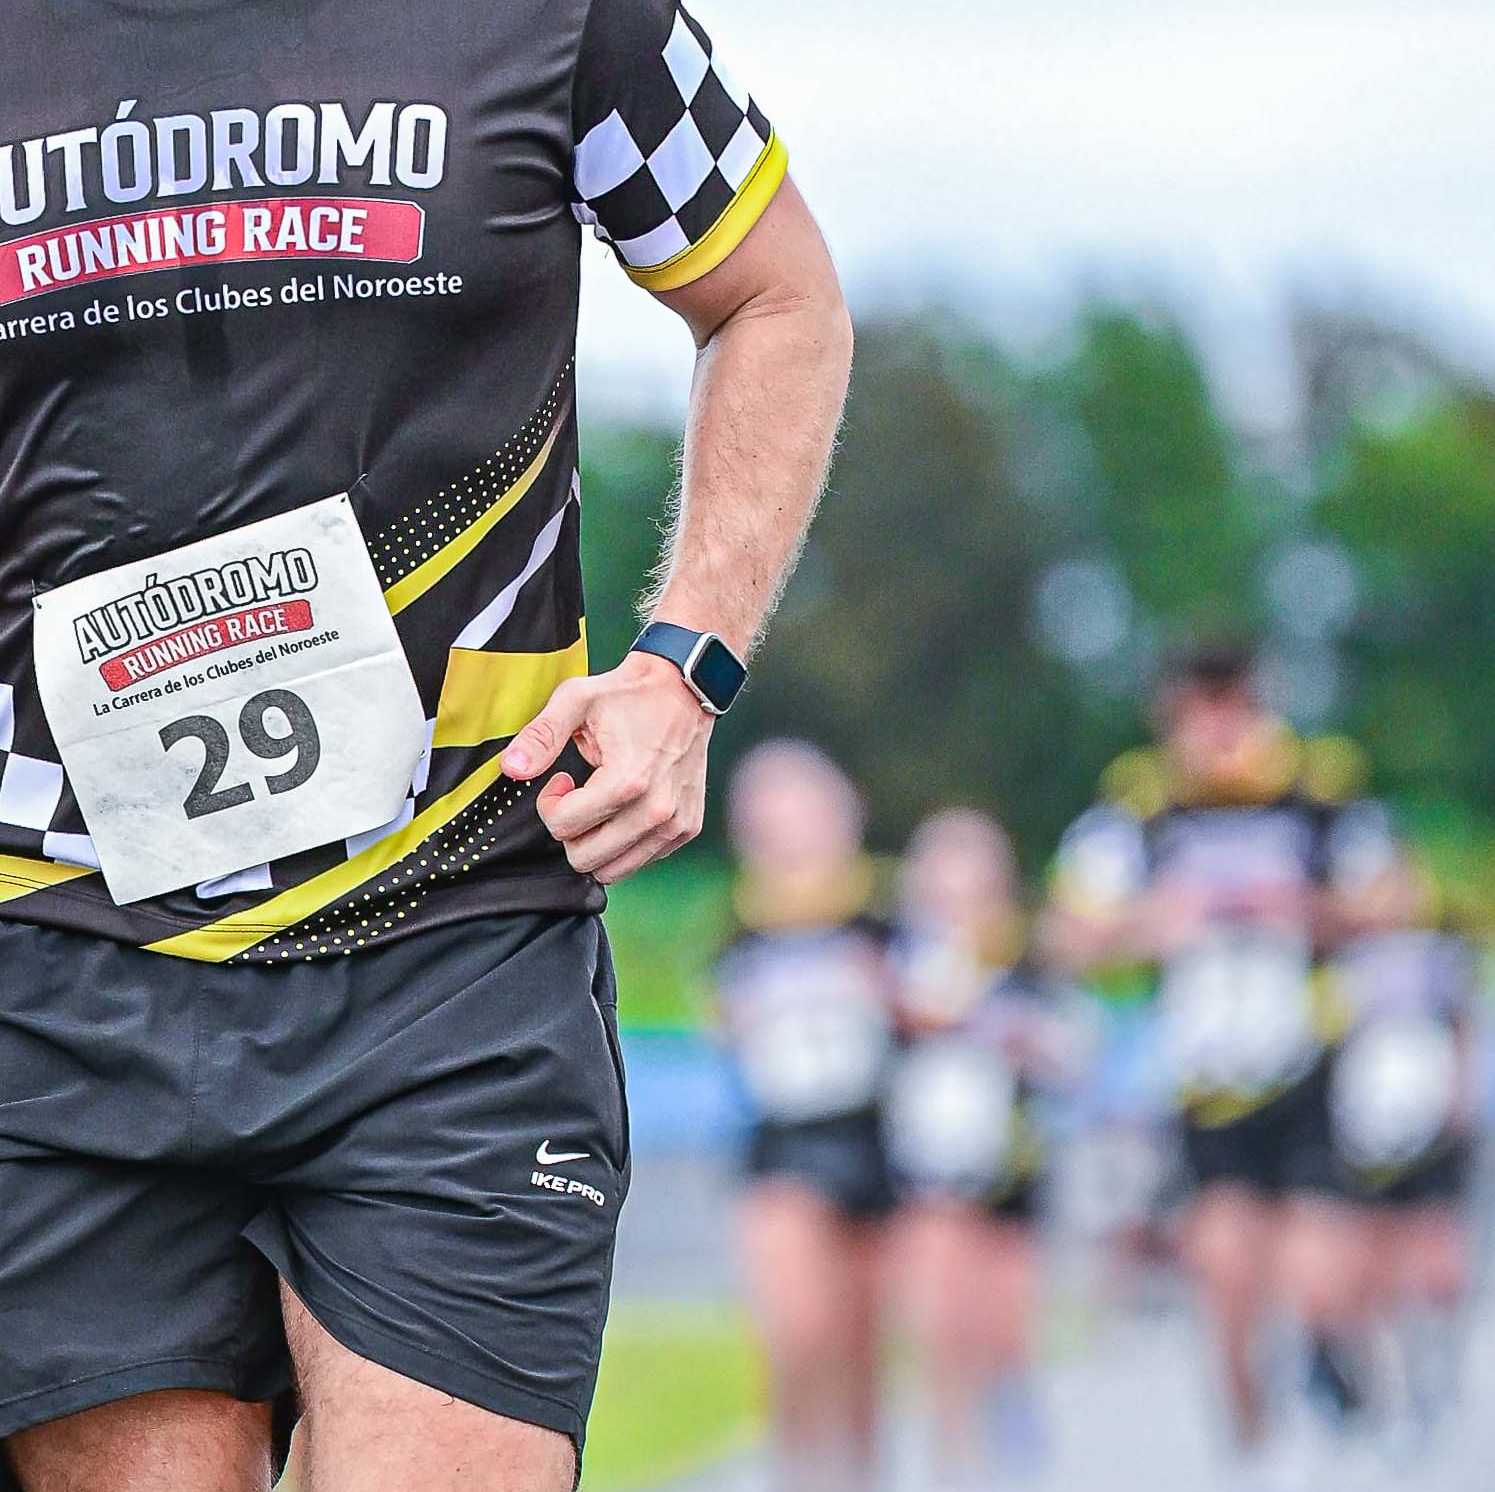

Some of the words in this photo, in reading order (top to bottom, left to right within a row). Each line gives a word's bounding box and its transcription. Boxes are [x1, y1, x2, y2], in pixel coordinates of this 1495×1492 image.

[15, 211, 227, 294] RUNNING
[241, 207, 369, 254] RACE
[84, 298, 120, 326] de
[127, 294, 169, 322] los
[175, 278, 273, 315] Clubes
[280, 275, 324, 305] del
[333, 271, 464, 302] Noroeste
[73, 548, 318, 663] AUTÓDROMO
[122, 623, 222, 681] RUNNING
[227, 608, 289, 643] RACE
[93, 701, 111, 717] La
[112, 684, 163, 711] Carrera
[164, 677, 183, 694] de
[183, 671, 205, 688] los
[206, 655, 254, 682] Clubes
[255, 646, 278, 665] del
[278, 628, 340, 658] Noroeste
[158, 688, 321, 820] 29
[567, 1180, 605, 1206] PRO
